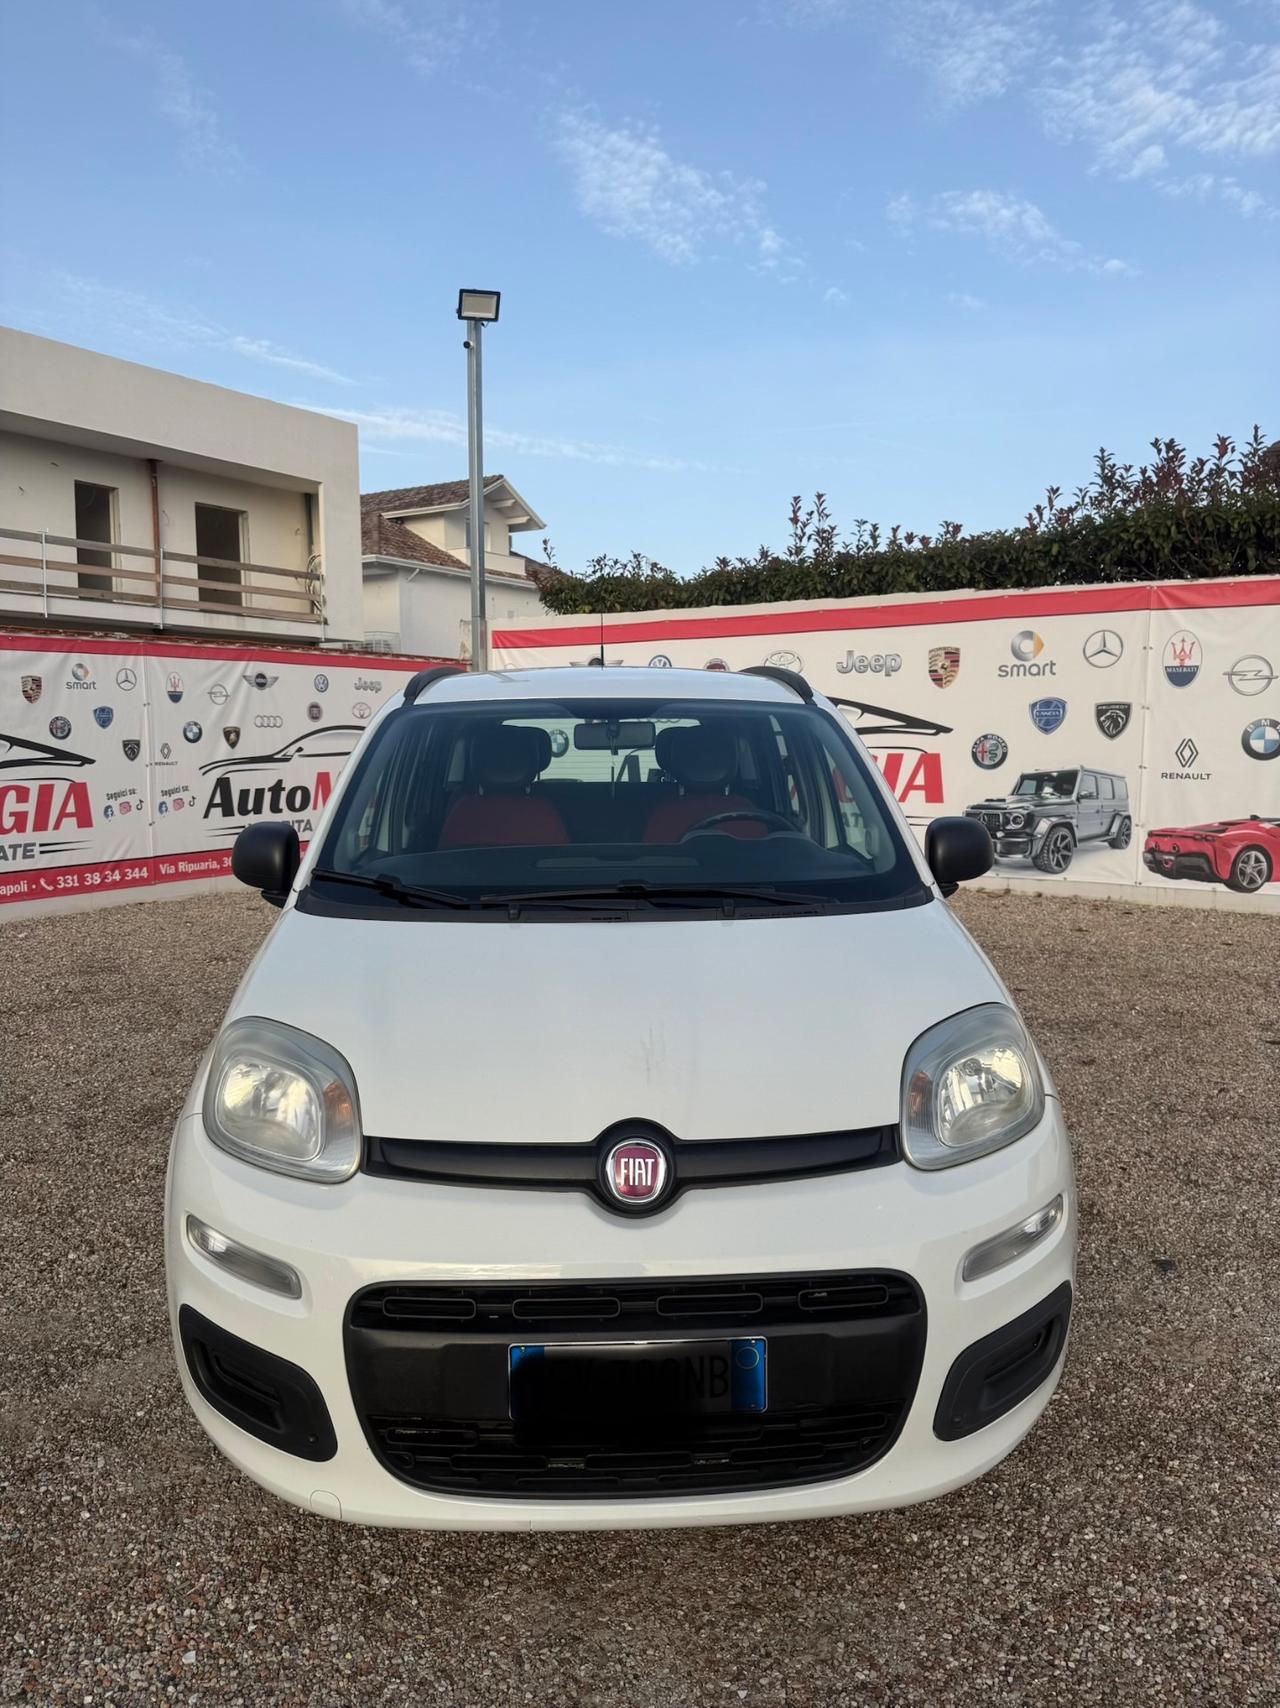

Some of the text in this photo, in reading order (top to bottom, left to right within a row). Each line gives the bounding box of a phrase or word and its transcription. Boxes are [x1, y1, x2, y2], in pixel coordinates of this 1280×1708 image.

[836, 649, 902, 676] Jeep
[998, 660, 1056, 678] smart
[66, 681, 97, 690] smart
[354, 677, 382, 693] Jeep
[1161, 772, 1212, 781] RENAULT
[105, 788, 127, 801] Seguici
[160, 785, 181, 797] Seguici
[159, 863, 176, 875] Via
[178, 859, 221, 873] Ripuaria,
[56, 874, 79, 889] 331
[84, 871, 101, 887] 38
[104, 869, 121, 883] 34
[124, 866, 149, 881] 344
[620, 1157, 655, 1187] FIAT
